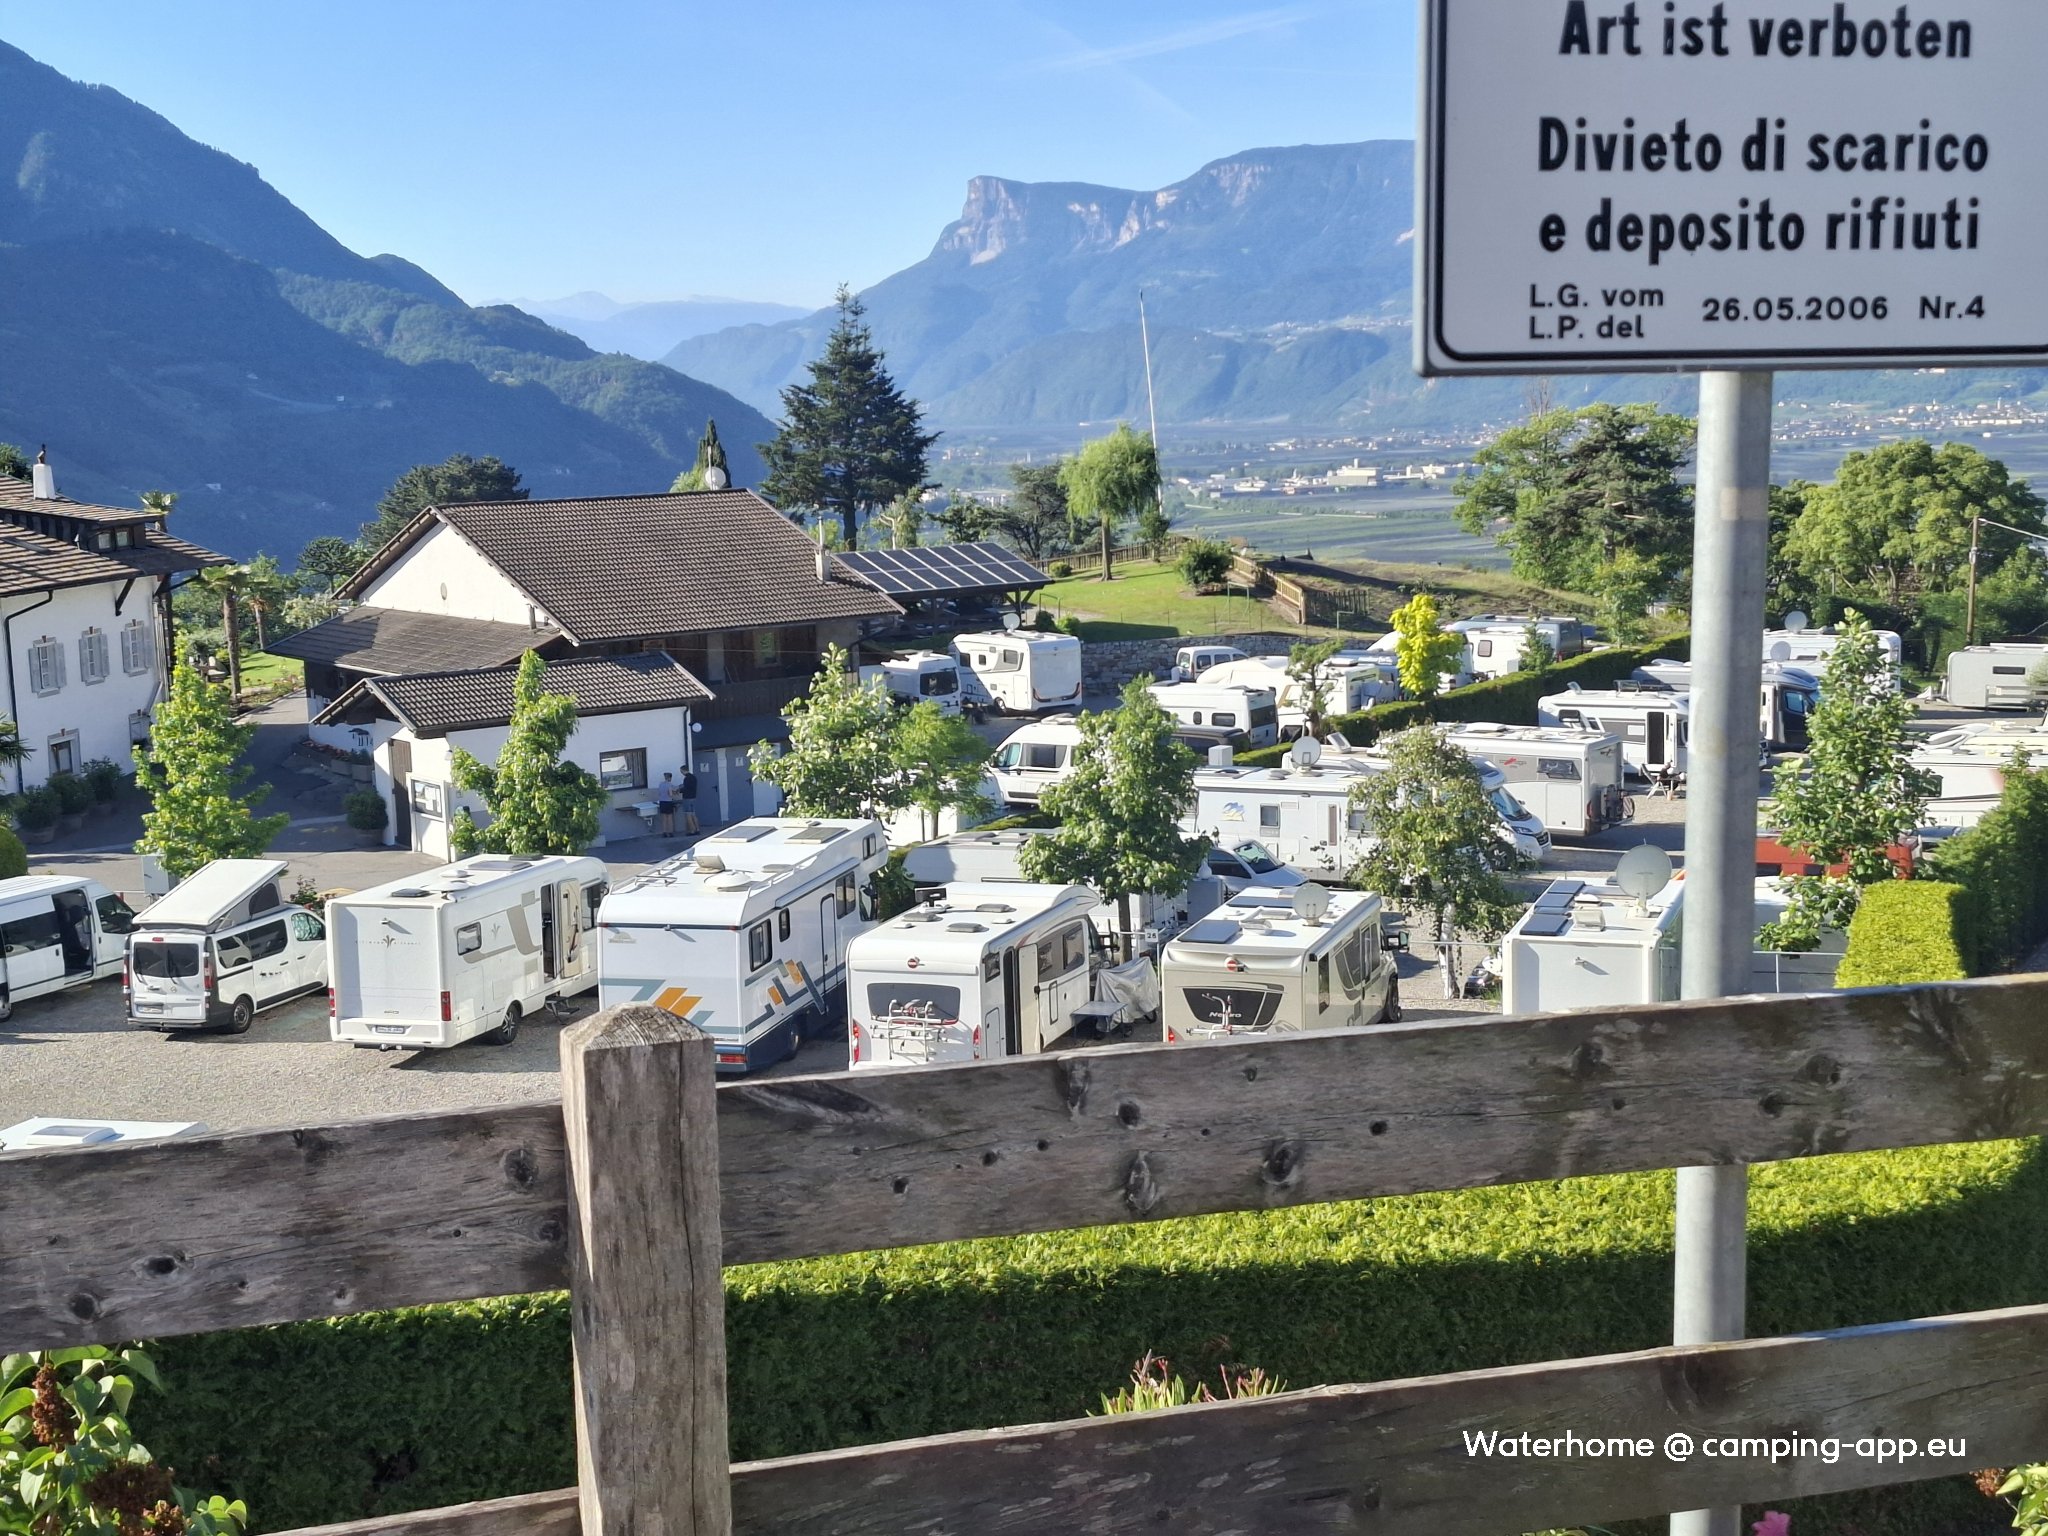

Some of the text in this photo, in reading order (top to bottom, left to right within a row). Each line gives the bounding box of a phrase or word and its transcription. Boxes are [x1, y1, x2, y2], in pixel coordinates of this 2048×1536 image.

[1559, 0, 1972, 59] Art ist verboten
[1538, 116, 1989, 172] Divieto di scarico
[1538, 196, 1980, 266] e deposito rifiuti
[1529, 283, 1664, 309] L.G. vom
[1701, 295, 1986, 322] 26.05.2006 Nr.4
[1528, 313, 1645, 340] L.P. del
